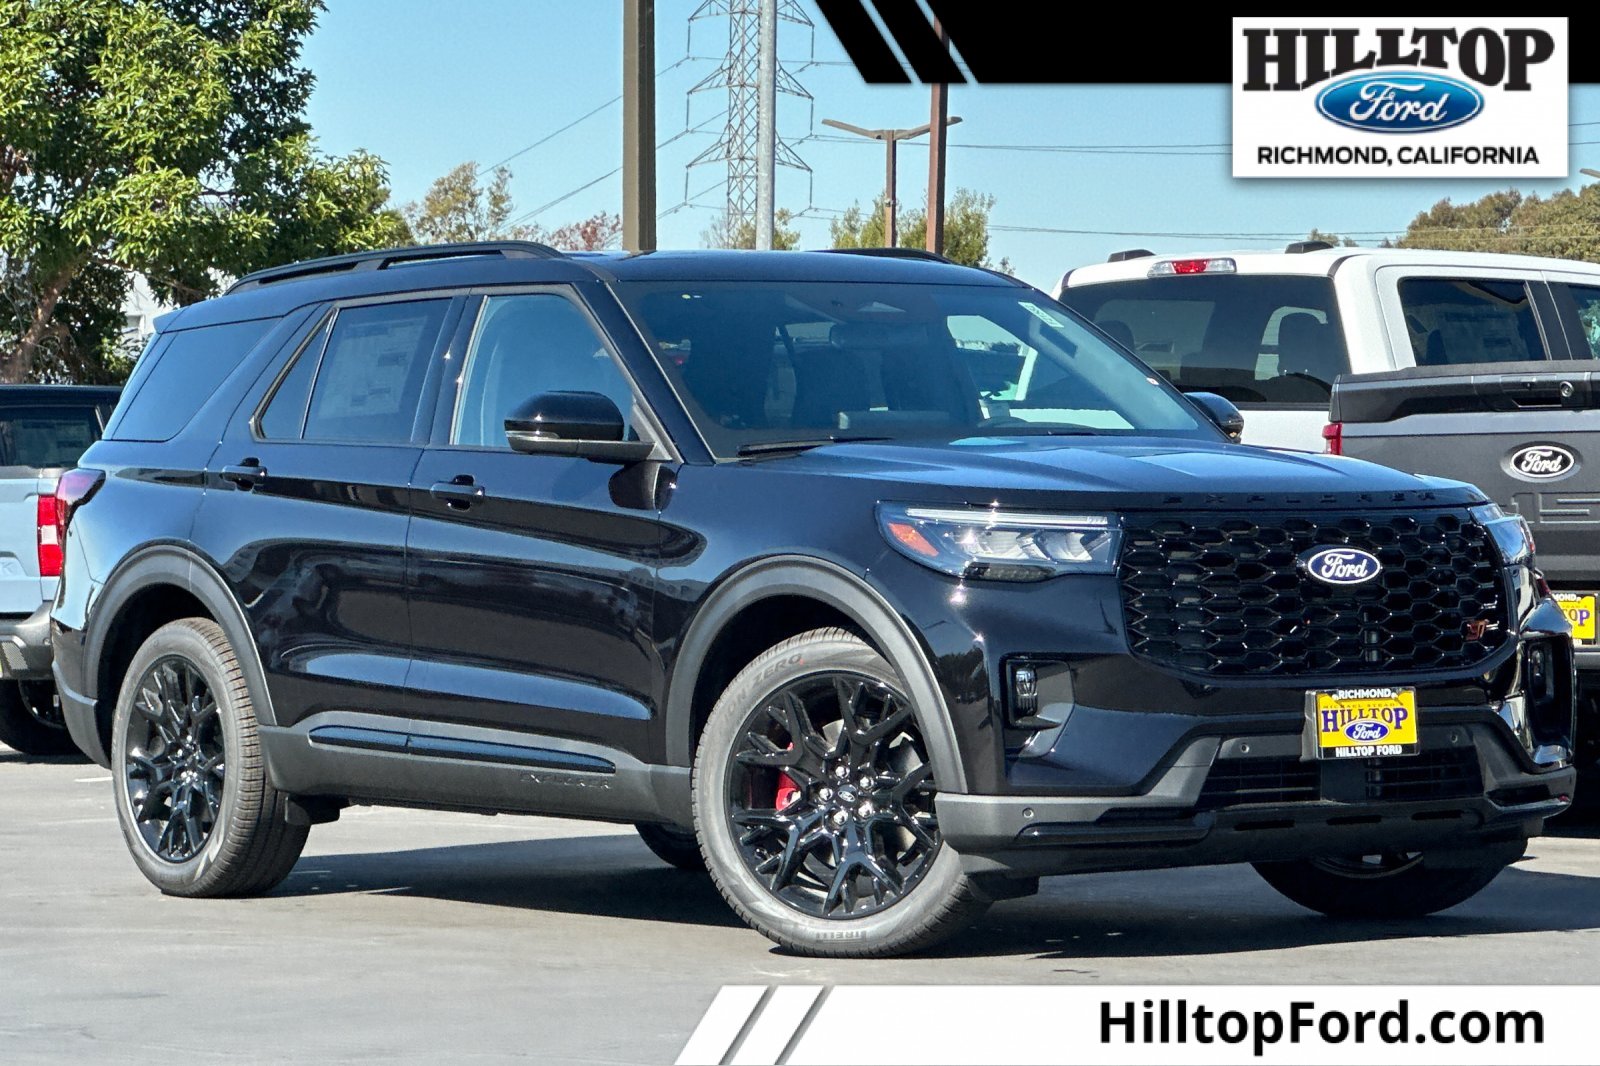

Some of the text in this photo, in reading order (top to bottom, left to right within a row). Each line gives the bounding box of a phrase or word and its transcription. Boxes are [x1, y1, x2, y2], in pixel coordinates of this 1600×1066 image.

[1521, 450, 1563, 472] Ford
[1321, 552, 1369, 578] Ford
[1338, 688, 1392, 700] RICHMOND
[1321, 707, 1409, 732] HILLTOP
[1352, 723, 1382, 740] Ford
[1335, 744, 1403, 757] HILLTOP FORD
